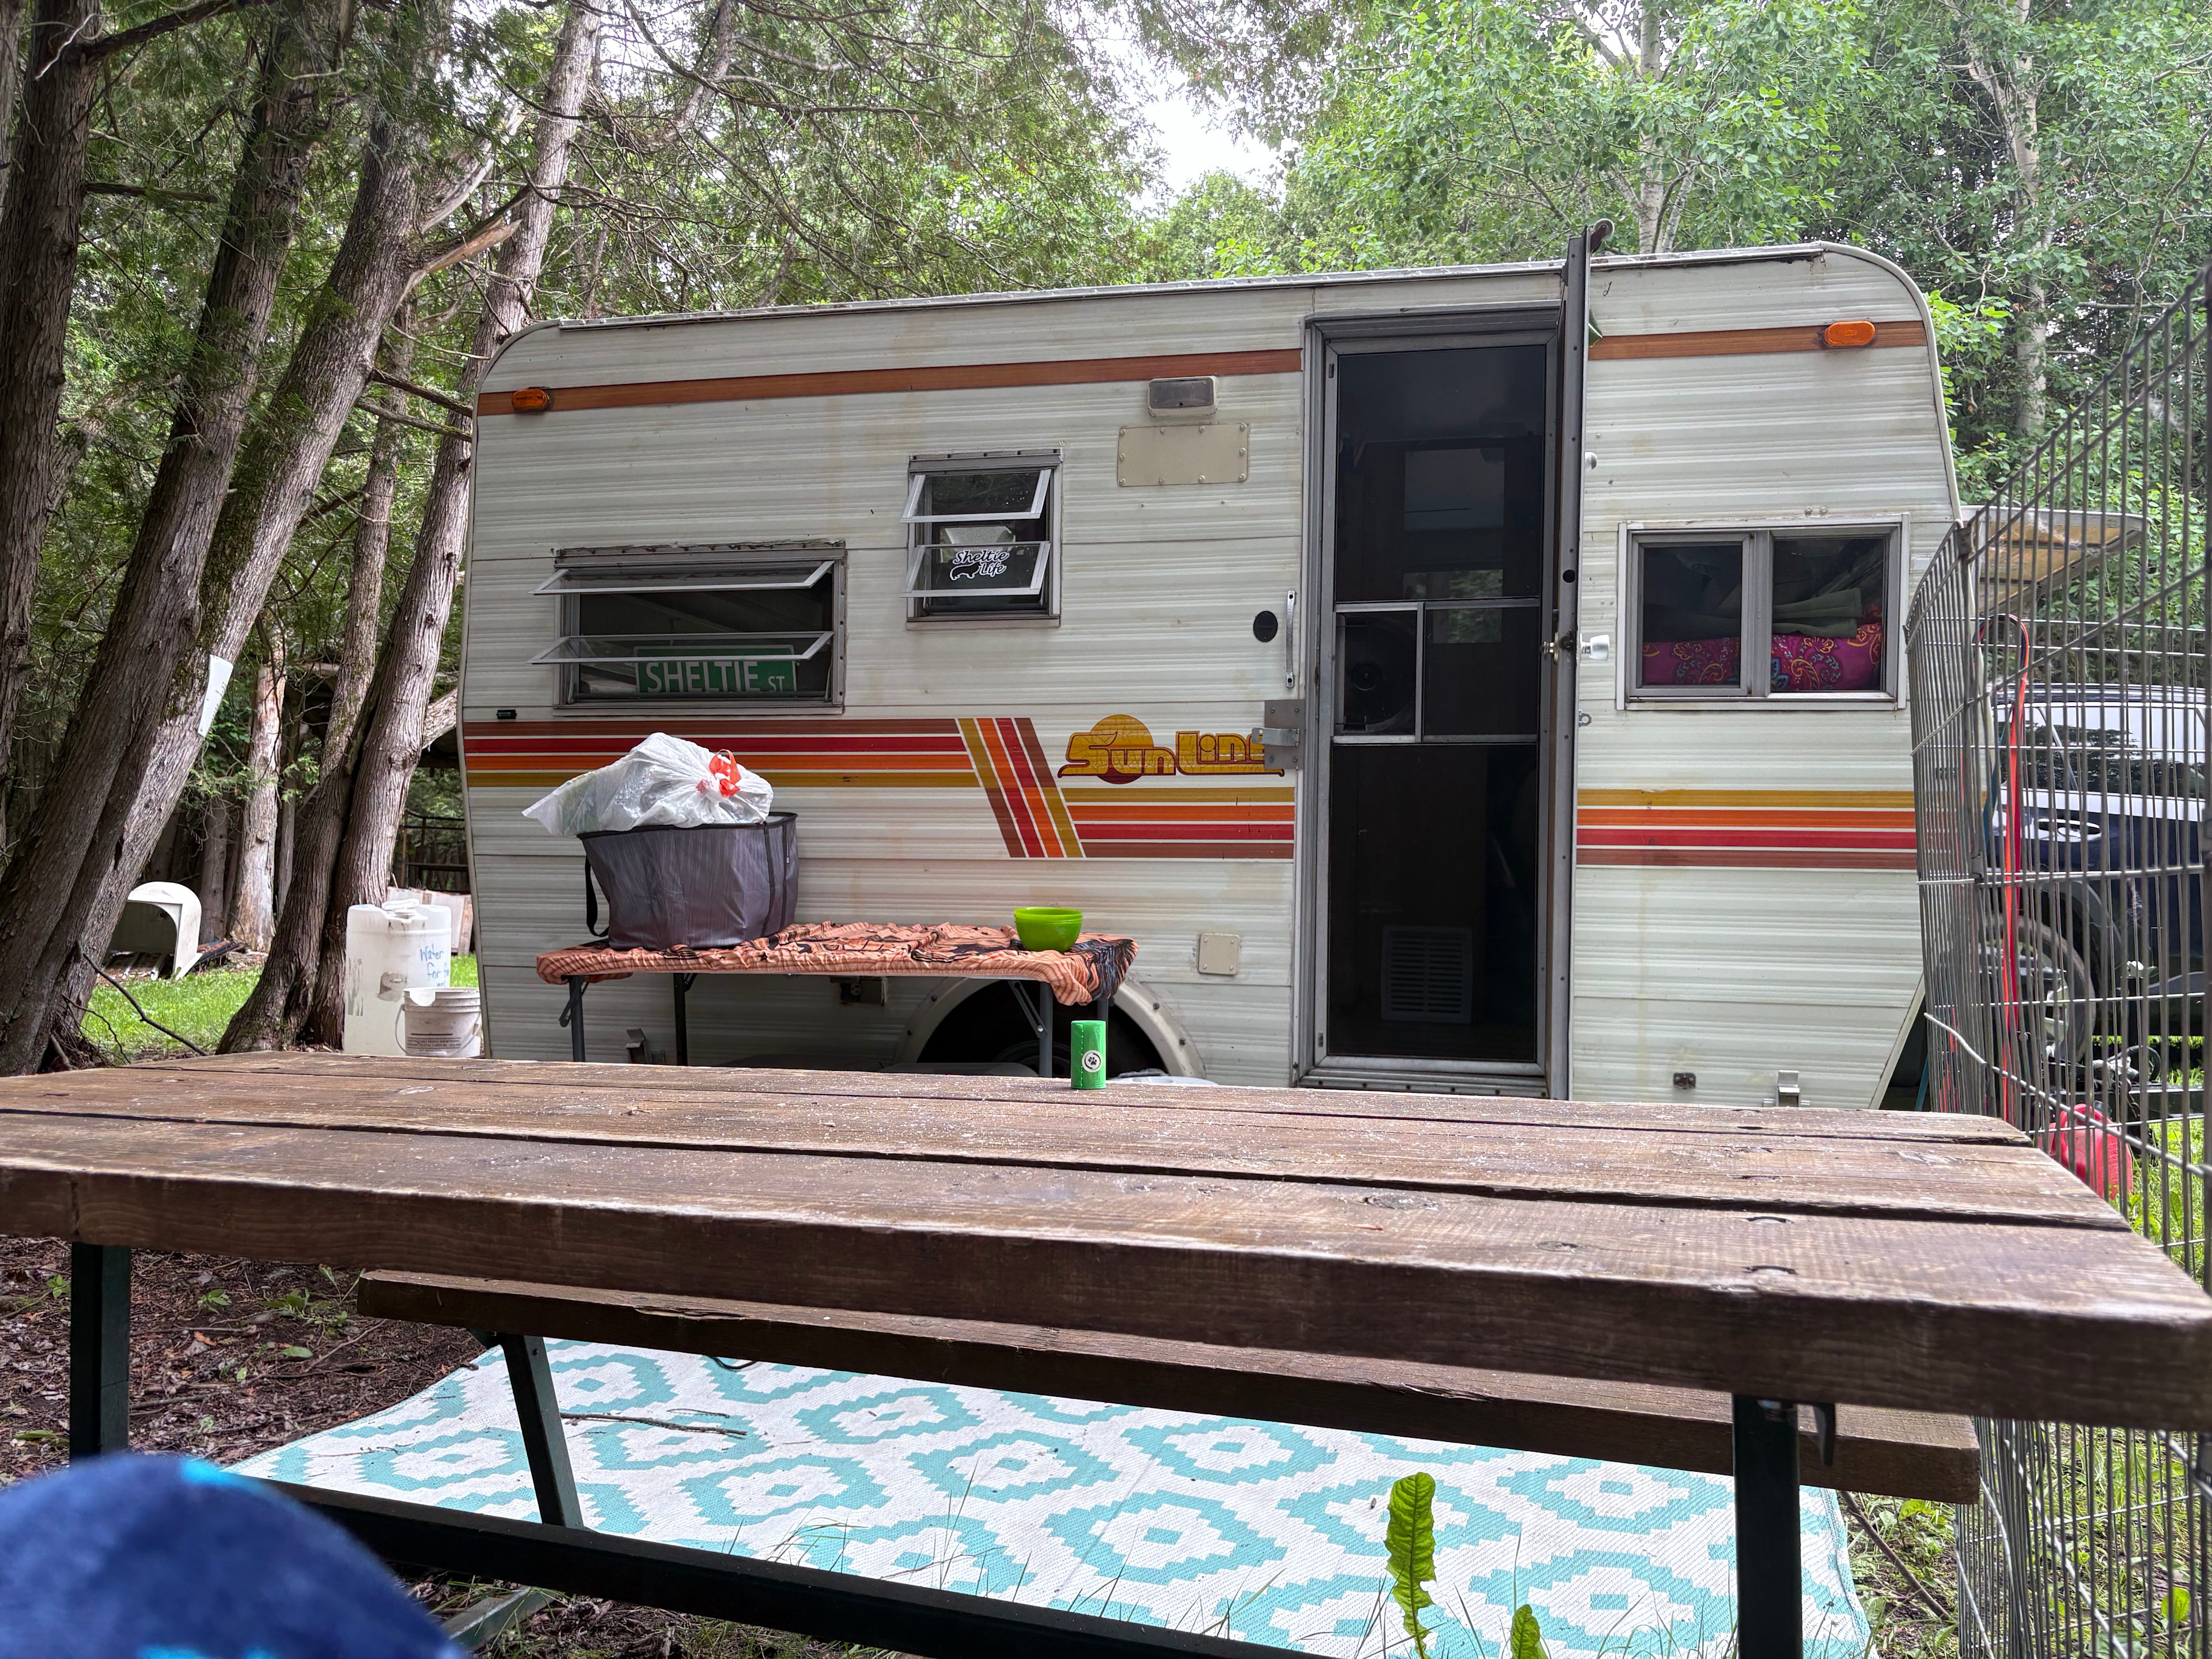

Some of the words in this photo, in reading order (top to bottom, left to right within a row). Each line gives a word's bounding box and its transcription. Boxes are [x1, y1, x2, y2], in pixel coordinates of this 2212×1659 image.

[953, 549, 1010, 564] Sheltie
[646, 661, 760, 692] SHELTIE
[768, 676, 785, 692] ST
[420, 943, 444, 961] Water
